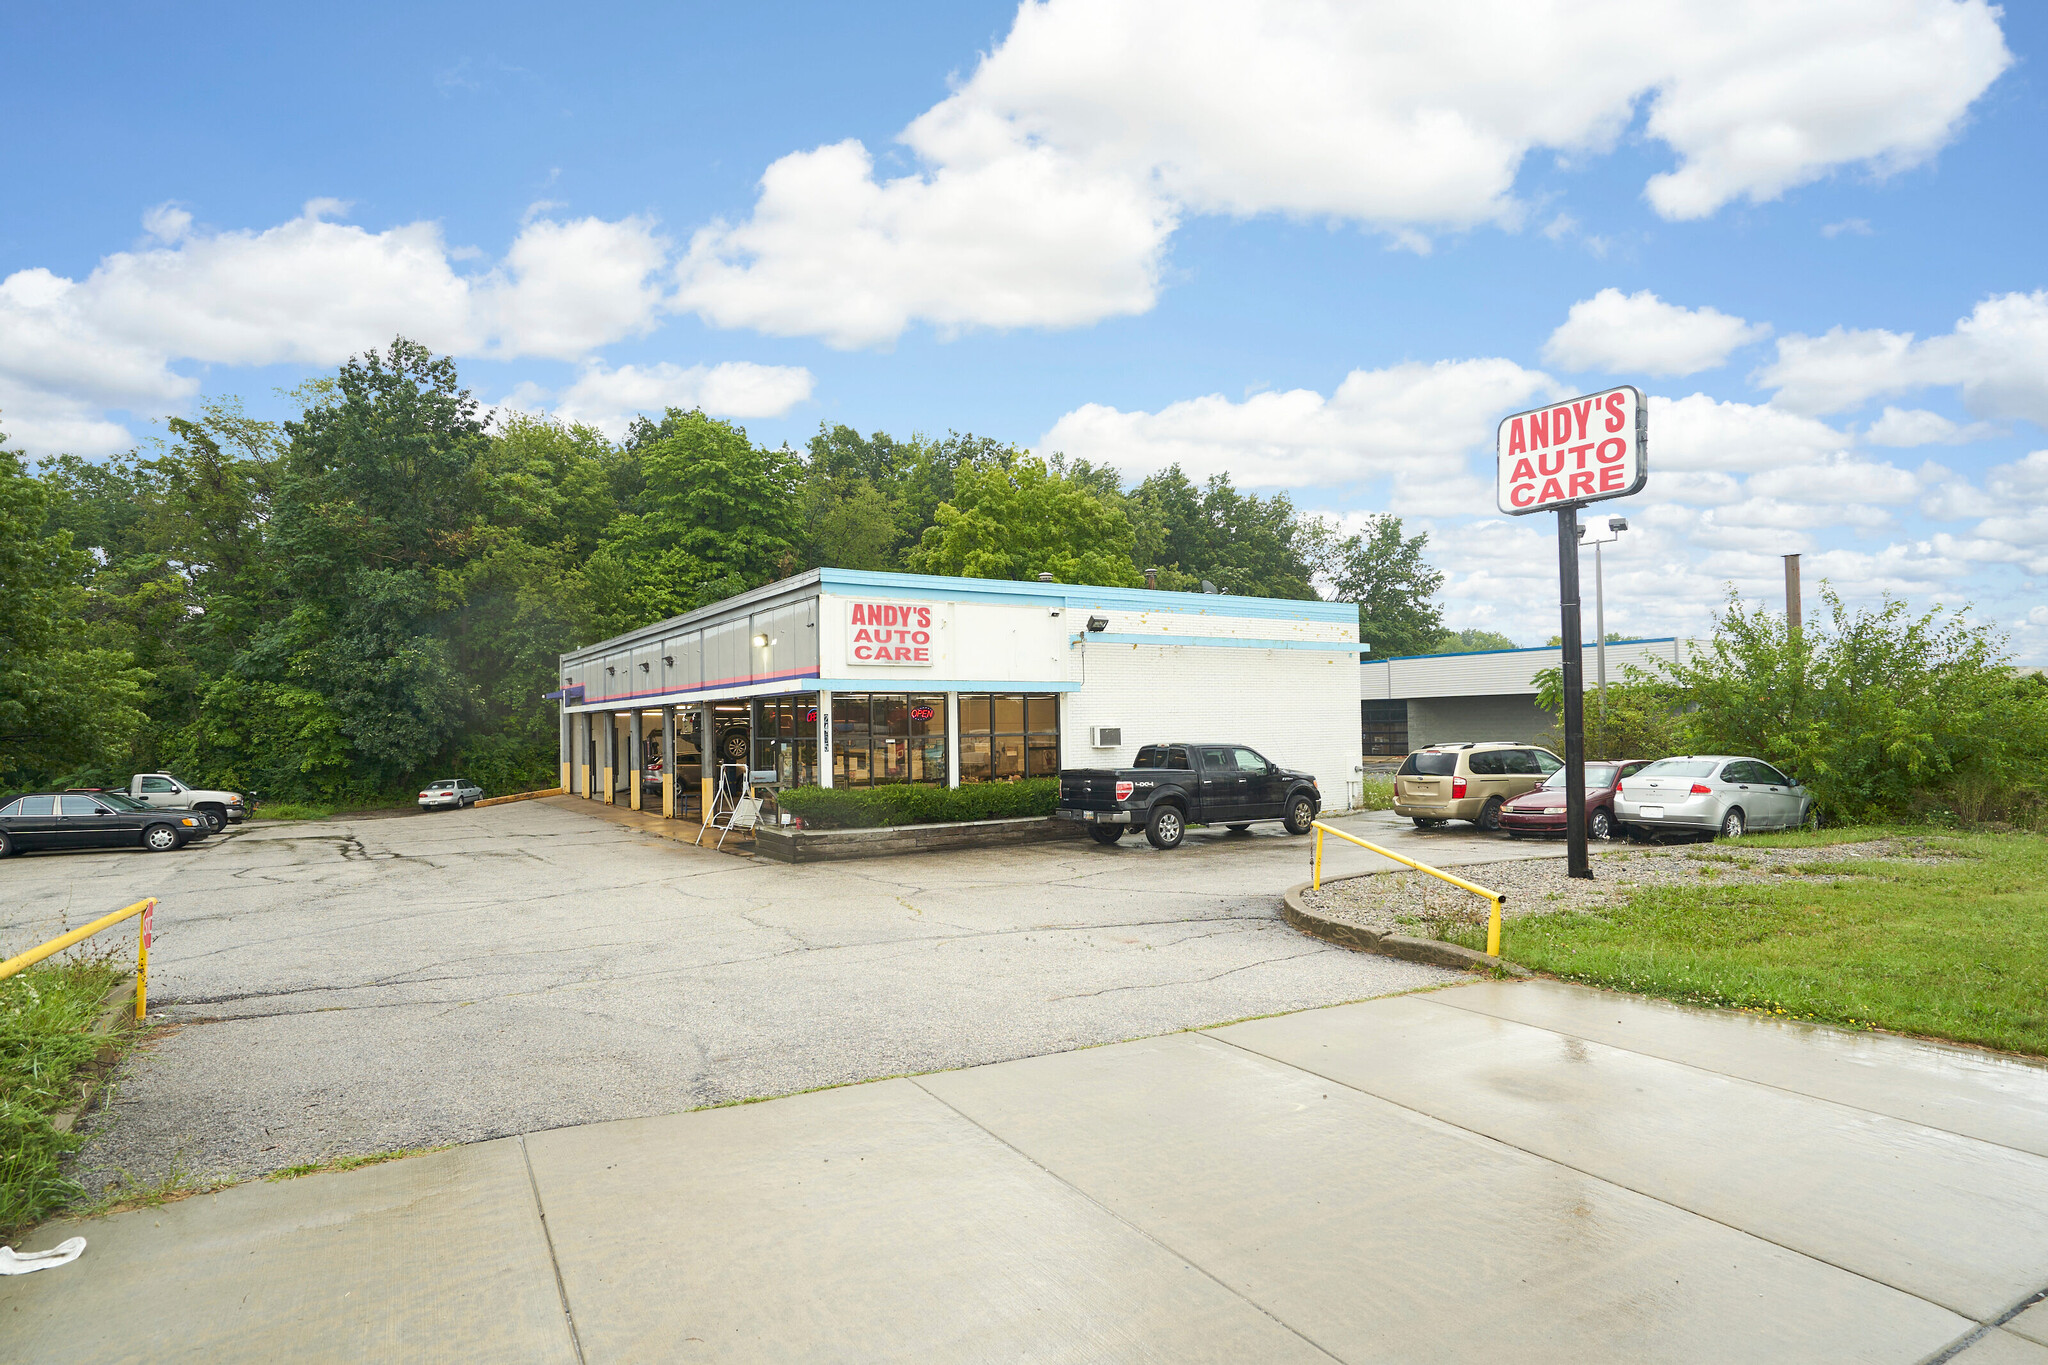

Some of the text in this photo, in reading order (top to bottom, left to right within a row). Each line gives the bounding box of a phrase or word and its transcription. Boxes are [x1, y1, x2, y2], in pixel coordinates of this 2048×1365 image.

[1508, 392, 1626, 456] ANDY'S
[1509, 437, 1627, 484] AUTO
[1510, 463, 1625, 508] CARE
[851, 603, 931, 629] ANDY'S
[853, 628, 931, 645] AUTO
[854, 645, 930, 662] CARE
[807, 711, 818, 723] OPE
[910, 709, 934, 718] OPEN
